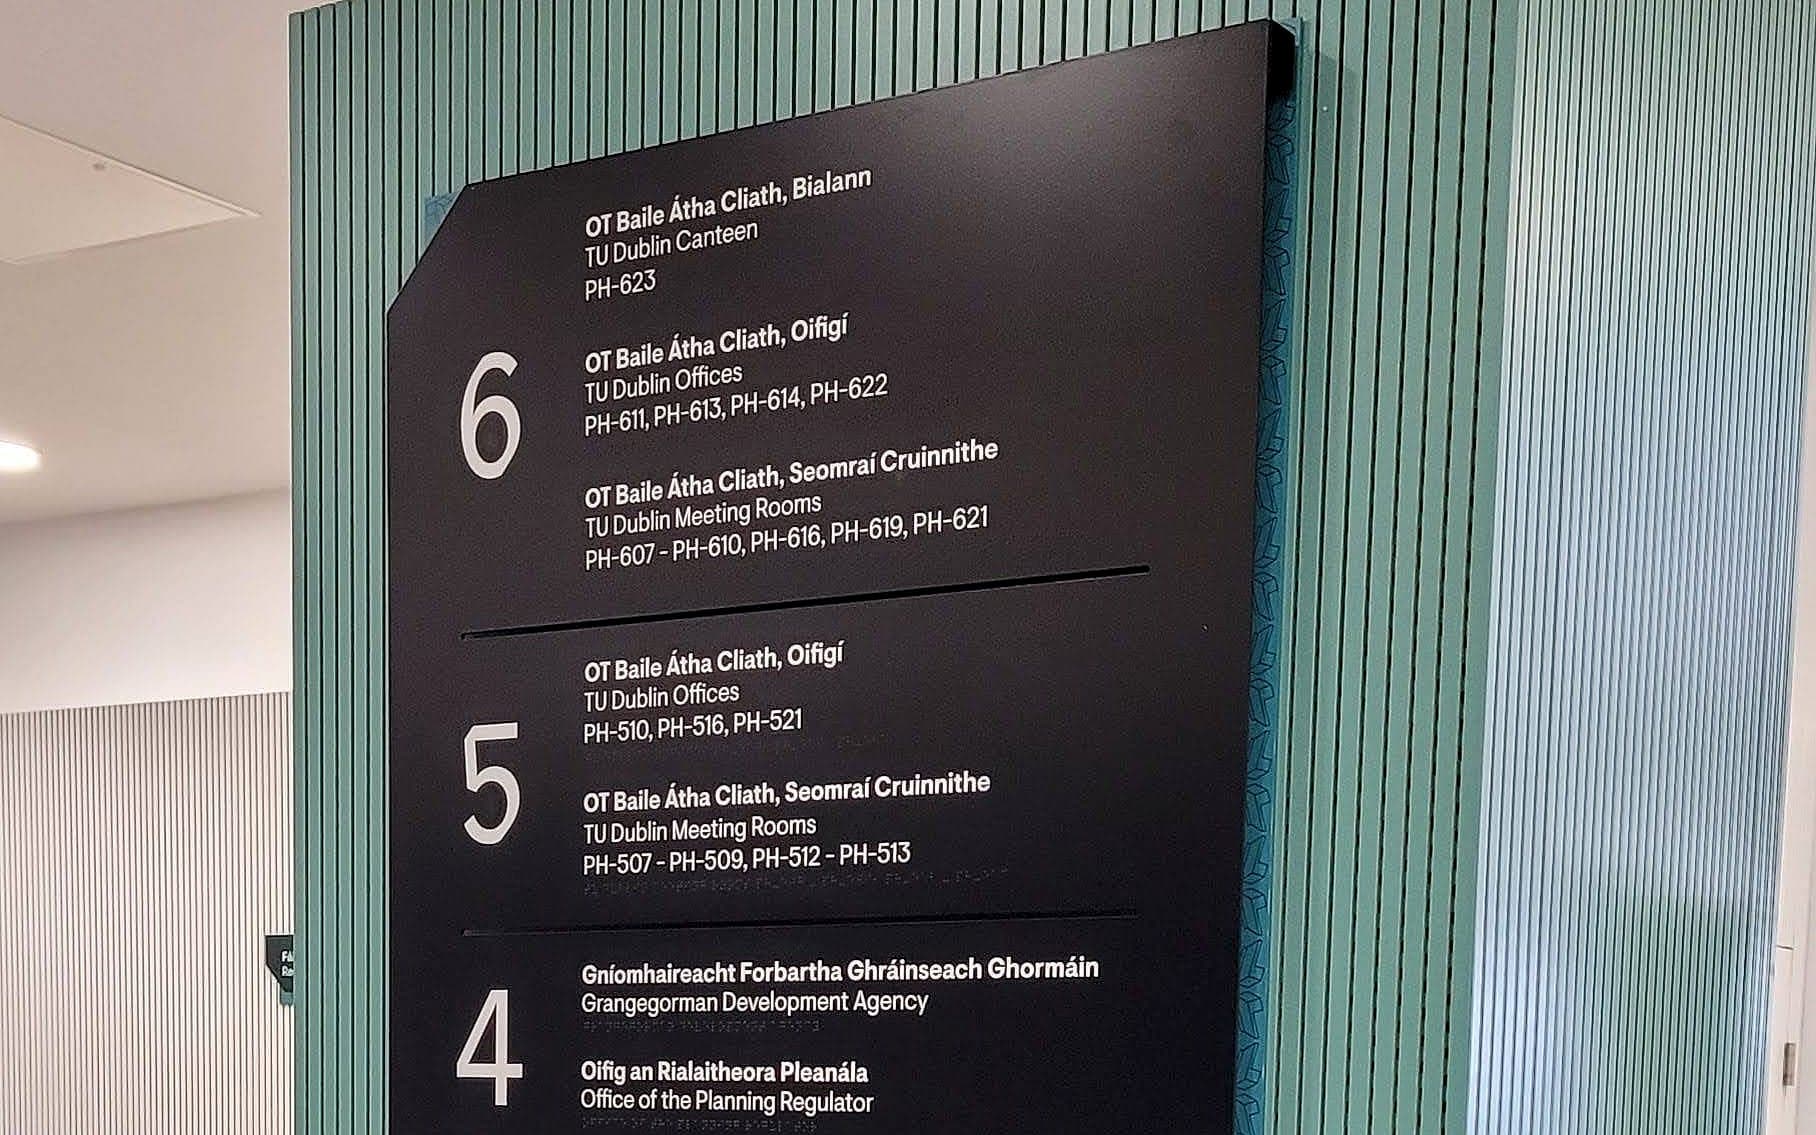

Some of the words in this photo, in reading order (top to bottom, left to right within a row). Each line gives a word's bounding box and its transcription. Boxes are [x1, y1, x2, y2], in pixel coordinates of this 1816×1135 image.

[585, 212, 613, 238] OT
[616, 204, 665, 234] Baile
[668, 194, 717, 224] Átha
[720, 181, 788, 213] Cliath,
[792, 169, 872, 201] Bialann
[584, 243, 609, 269] TU
[613, 234, 672, 264] Dublin
[675, 221, 758, 253] Canteen
[585, 267, 656, 302] PH-623
[585, 349, 613, 375] OT
[616, 341, 665, 371] Baile
[667, 332, 716, 363] Átha
[719, 322, 787, 354] Cliath,
[790, 311, 849, 343] Oifigí
[584, 379, 609, 405] TU
[612, 372, 671, 401] Dublin
[674, 363, 743, 392] Offices
[585, 406, 650, 437] PH-611,
[654, 395, 727, 428] PH-613,
[730, 384, 806, 417] PH-614,
[810, 371, 888, 406] PH-622
[460, 351, 521, 480] 6
[584, 484, 612, 510] OT
[615, 478, 664, 507] Baile
[666, 471, 715, 500] Átha
[718, 463, 785, 493] Cliath,
[788, 450, 877, 485] Seomraí
[880, 437, 999, 473] Cruinnithe
[584, 515, 609, 539] TU
[613, 508, 671, 536] Dublin
[675, 500, 751, 530] Meeting
[755, 494, 822, 520] Rooms
[585, 542, 656, 571] PH-607
[672, 532, 747, 563] PH-610,
[750, 523, 826, 554] PH-616,
[830, 513, 909, 545] PH-619,
[913, 504, 988, 536] PH-621
[584, 659, 612, 684] OT
[614, 656, 663, 682] Baile
[665, 648, 714, 677] Átha
[716, 645, 783, 673] Cliath,
[787, 639, 845, 669] Oifigí
[583, 689, 608, 713] TU
[611, 685, 669, 711] Dublin
[672, 680, 740, 707] Offices
[583, 718, 654, 745] PH-510,
[657, 712, 730, 740] PH-516,
[733, 707, 802, 734] PH-521
[463, 721, 521, 845] 5
[583, 790, 611, 814] OT
[613, 788, 662, 813] Baile
[664, 781, 712, 810] Átha
[714, 781, 781, 808] Cliath,
[784, 776, 872, 804] Seomraí
[874, 769, 991, 798] Cruinnithe
[583, 822, 607, 845] TU
[610, 819, 668, 844] Dublin
[671, 816, 747, 844] Meeting
[751, 814, 817, 838] Rooms
[583, 851, 653, 877] PH-507
[669, 847, 749, 874] PH-509,
[752, 844, 821, 870] PH-512
[839, 840, 911, 866] PH-513
[581, 961, 737, 985] Gníomhaireacht
[740, 958, 844, 984] Forbartha
[847, 955, 983, 982] Ghráinseach
[987, 954, 1099, 980] Ghormáin
[581, 991, 718, 1019] Grangegorman
[722, 989, 850, 1018] Development
[852, 989, 930, 1017] Agency
[456, 989, 524, 1107] 4
[580, 1059, 627, 1087] Oifig
[629, 1065, 654, 1082] an
[657, 1059, 777, 1083] Rialaitheora
[780, 1059, 869, 1084] Pleanála
[580, 1087, 635, 1110] Office
[638, 1086, 658, 1111] of
[660, 1088, 692, 1111] the
[695, 1088, 776, 1117] Planning
[780, 1089, 875, 1118] Regulator
